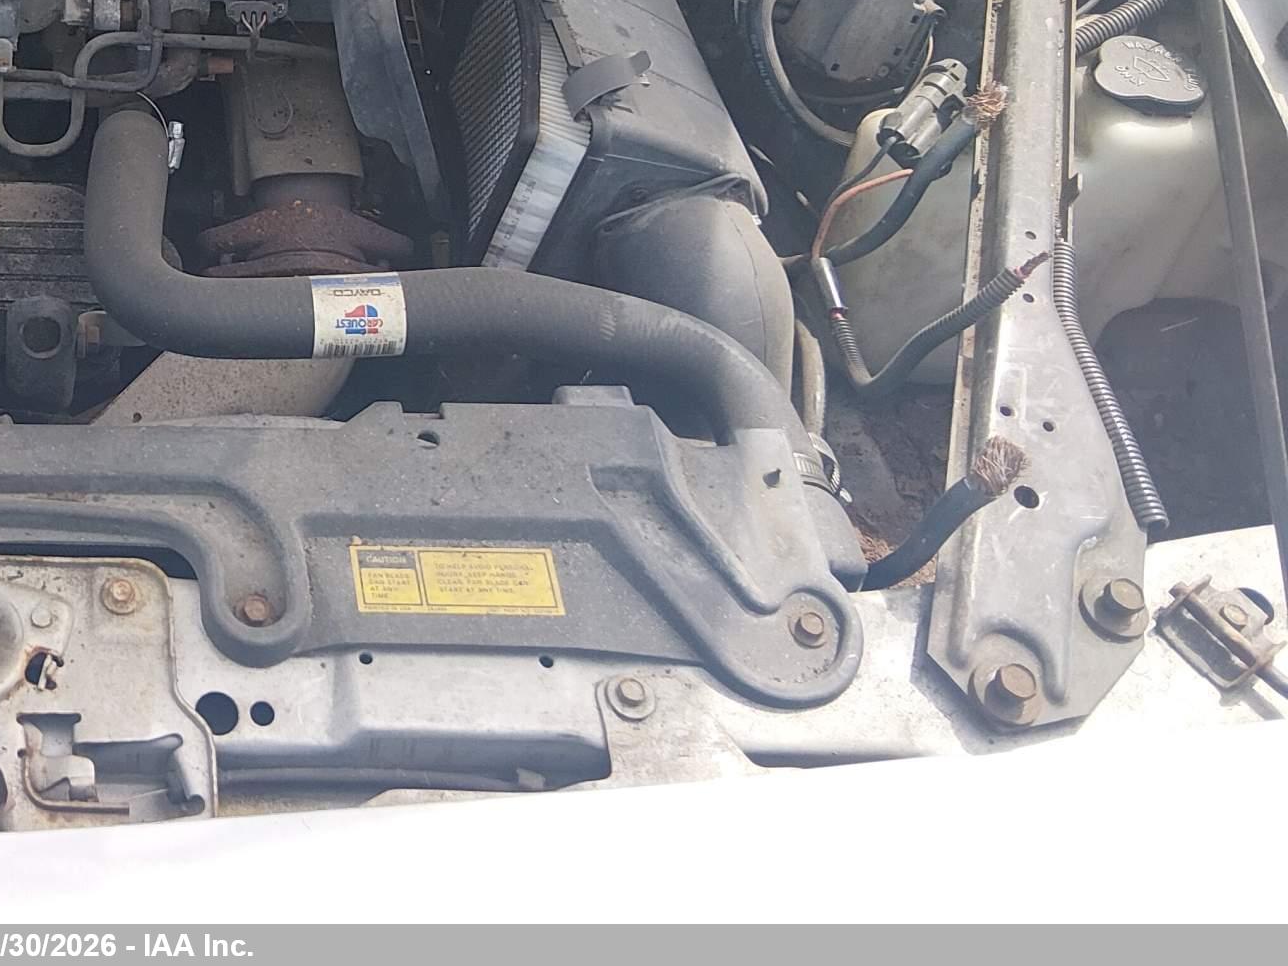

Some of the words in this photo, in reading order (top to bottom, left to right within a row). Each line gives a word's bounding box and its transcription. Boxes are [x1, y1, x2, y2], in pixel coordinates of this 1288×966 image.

[332, 288, 382, 298] DAYCO
[334, 317, 384, 330] CARQUEST
[366, 554, 407, 564] CAUTION
